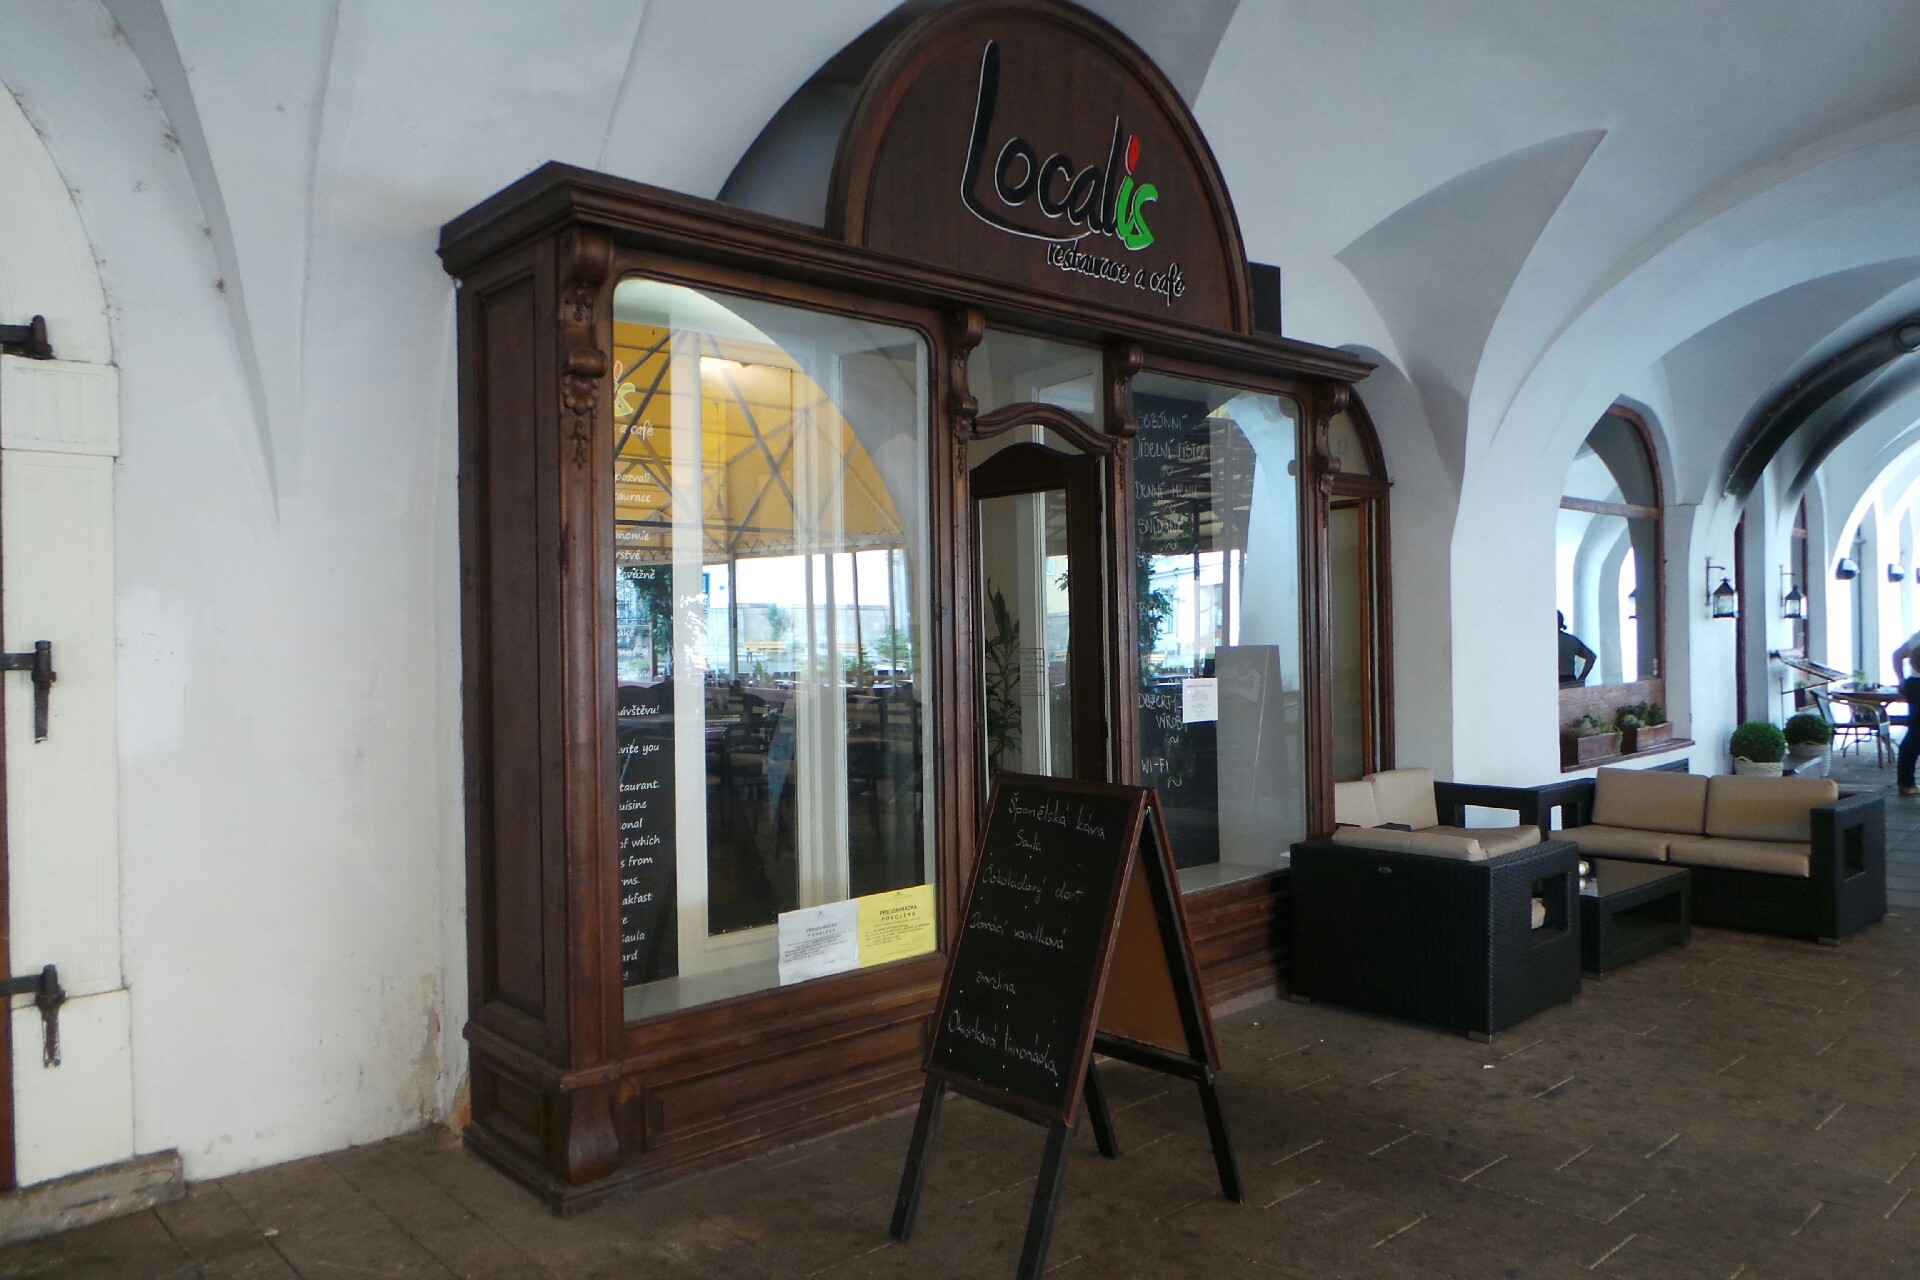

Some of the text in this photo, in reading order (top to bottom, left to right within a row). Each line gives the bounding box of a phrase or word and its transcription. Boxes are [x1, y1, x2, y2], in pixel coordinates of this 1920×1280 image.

[961, 38, 1159, 250] Localis
[1046, 240, 1186, 307] restaurace a café
[630, 419, 654, 441] café
[618, 705, 660, 716] ávštěvu!
[618, 743, 660, 756] vite you
[1141, 758, 1169, 774] WI-FI
[1008, 791, 1105, 840] Španělská káva
[631, 835, 660, 848] which
[628, 856, 653, 867] from
[621, 877, 640, 886] ms.
